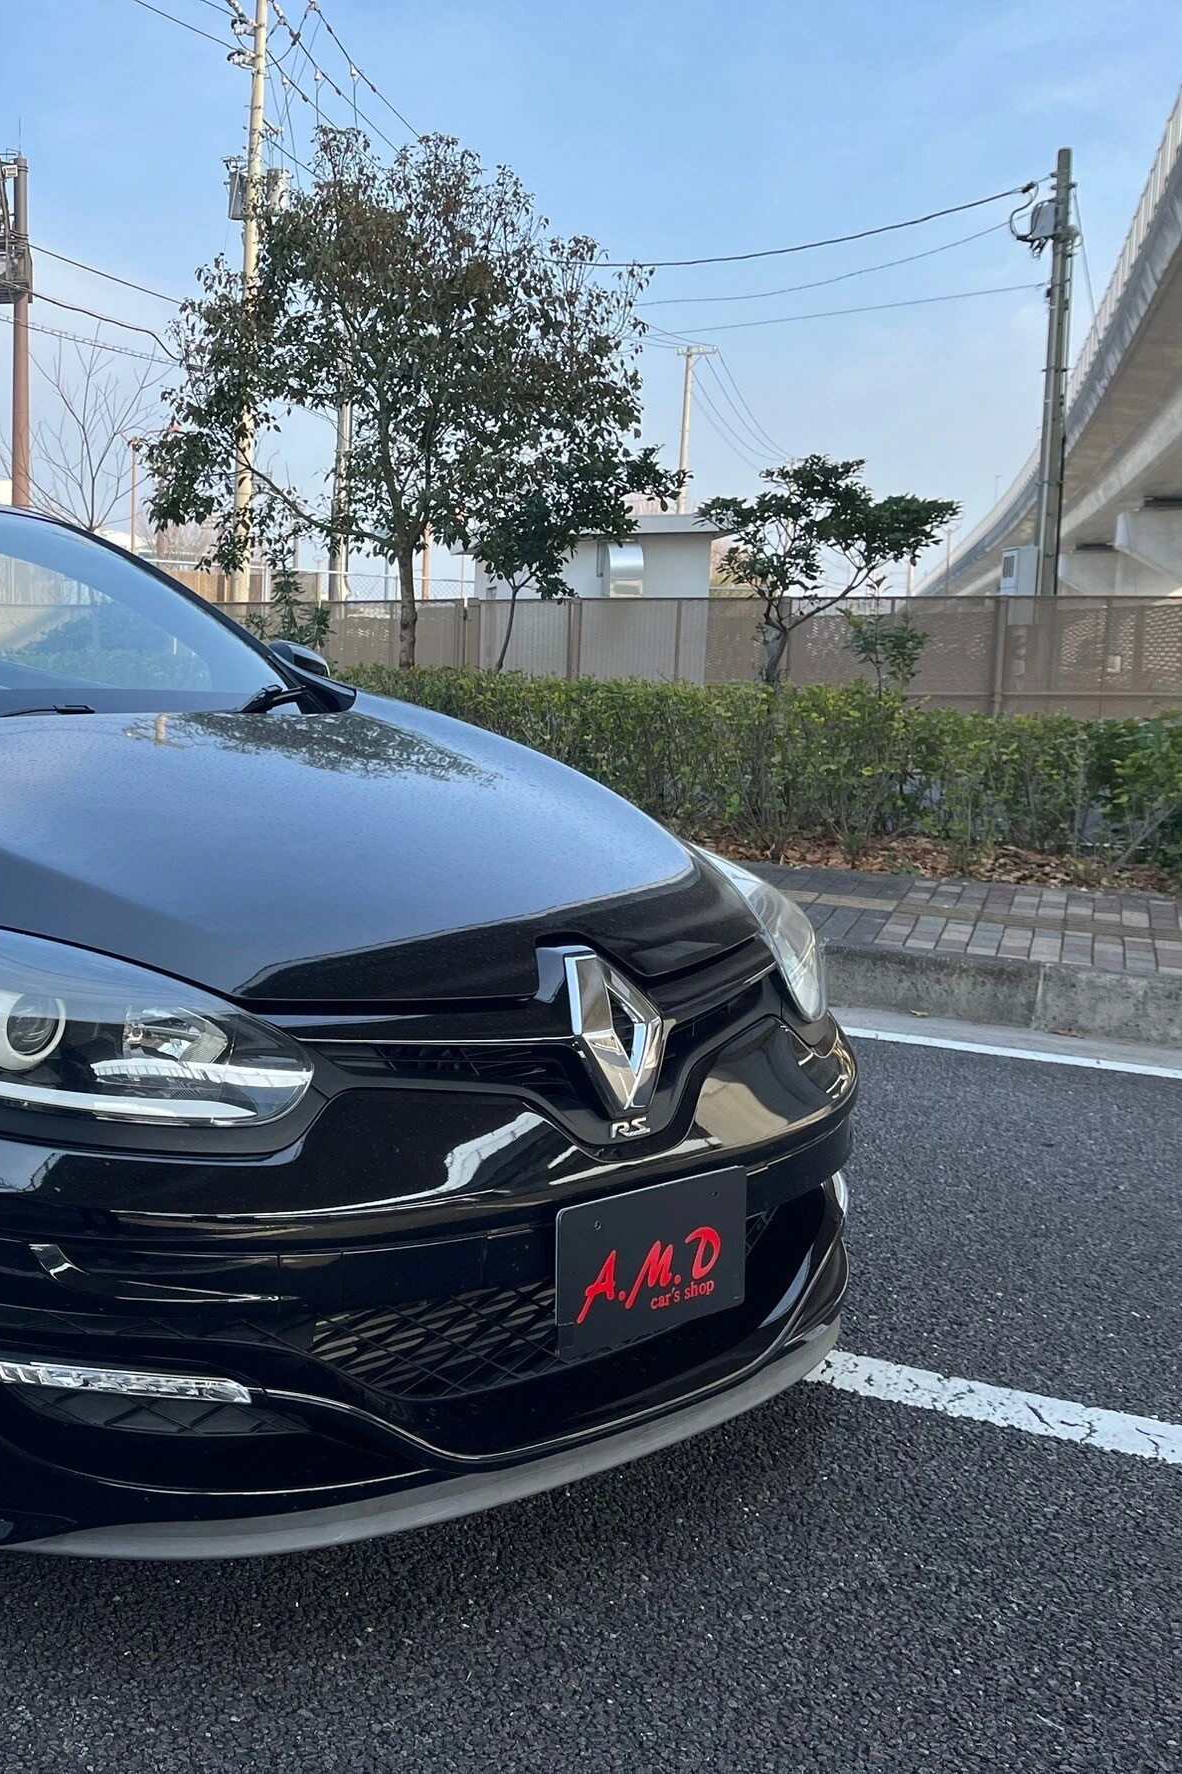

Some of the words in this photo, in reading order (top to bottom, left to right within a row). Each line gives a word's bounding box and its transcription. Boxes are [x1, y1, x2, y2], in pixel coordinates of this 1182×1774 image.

[610, 1116, 651, 1139] RS
[576, 1226, 722, 1325] A.M.D
[650, 1287, 681, 1310] car's
[684, 1279, 714, 1301] shop
